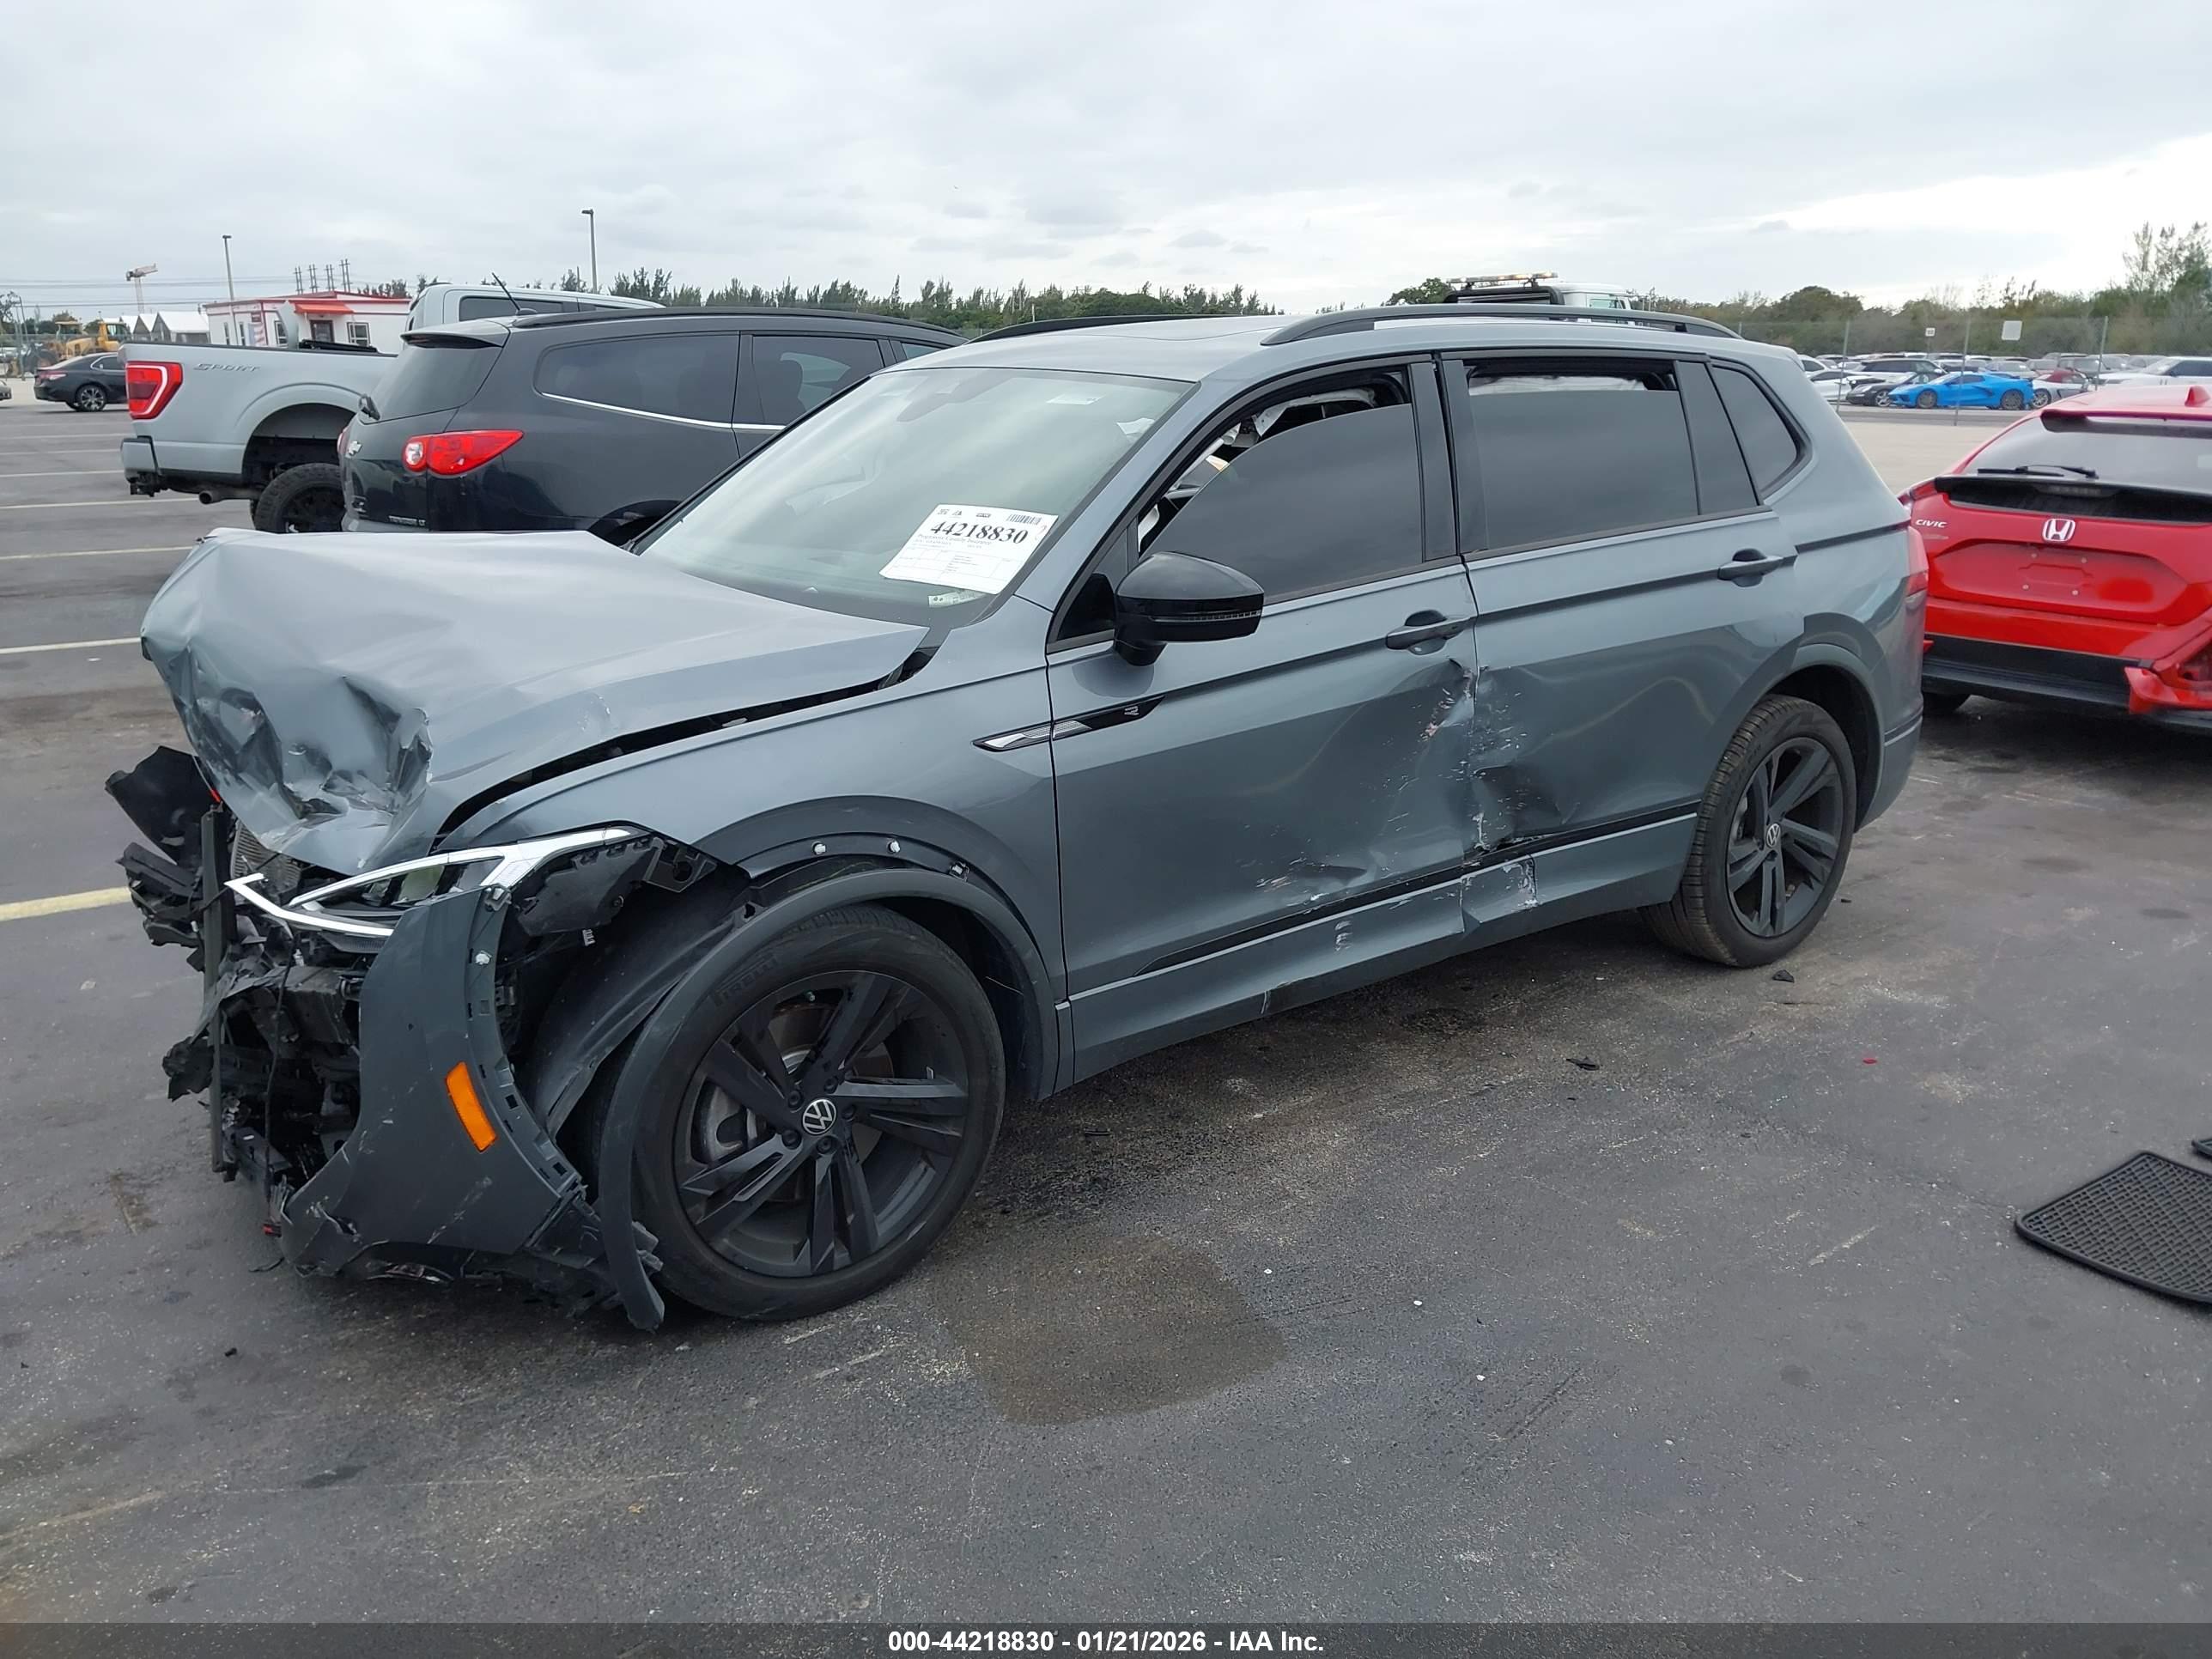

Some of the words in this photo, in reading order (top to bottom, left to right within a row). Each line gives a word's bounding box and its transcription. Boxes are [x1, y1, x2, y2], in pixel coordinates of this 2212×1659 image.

[193, 363, 261, 372] SPORT
[1916, 519, 1948, 528] CIVIC
[931, 521, 1028, 544] 44218830
